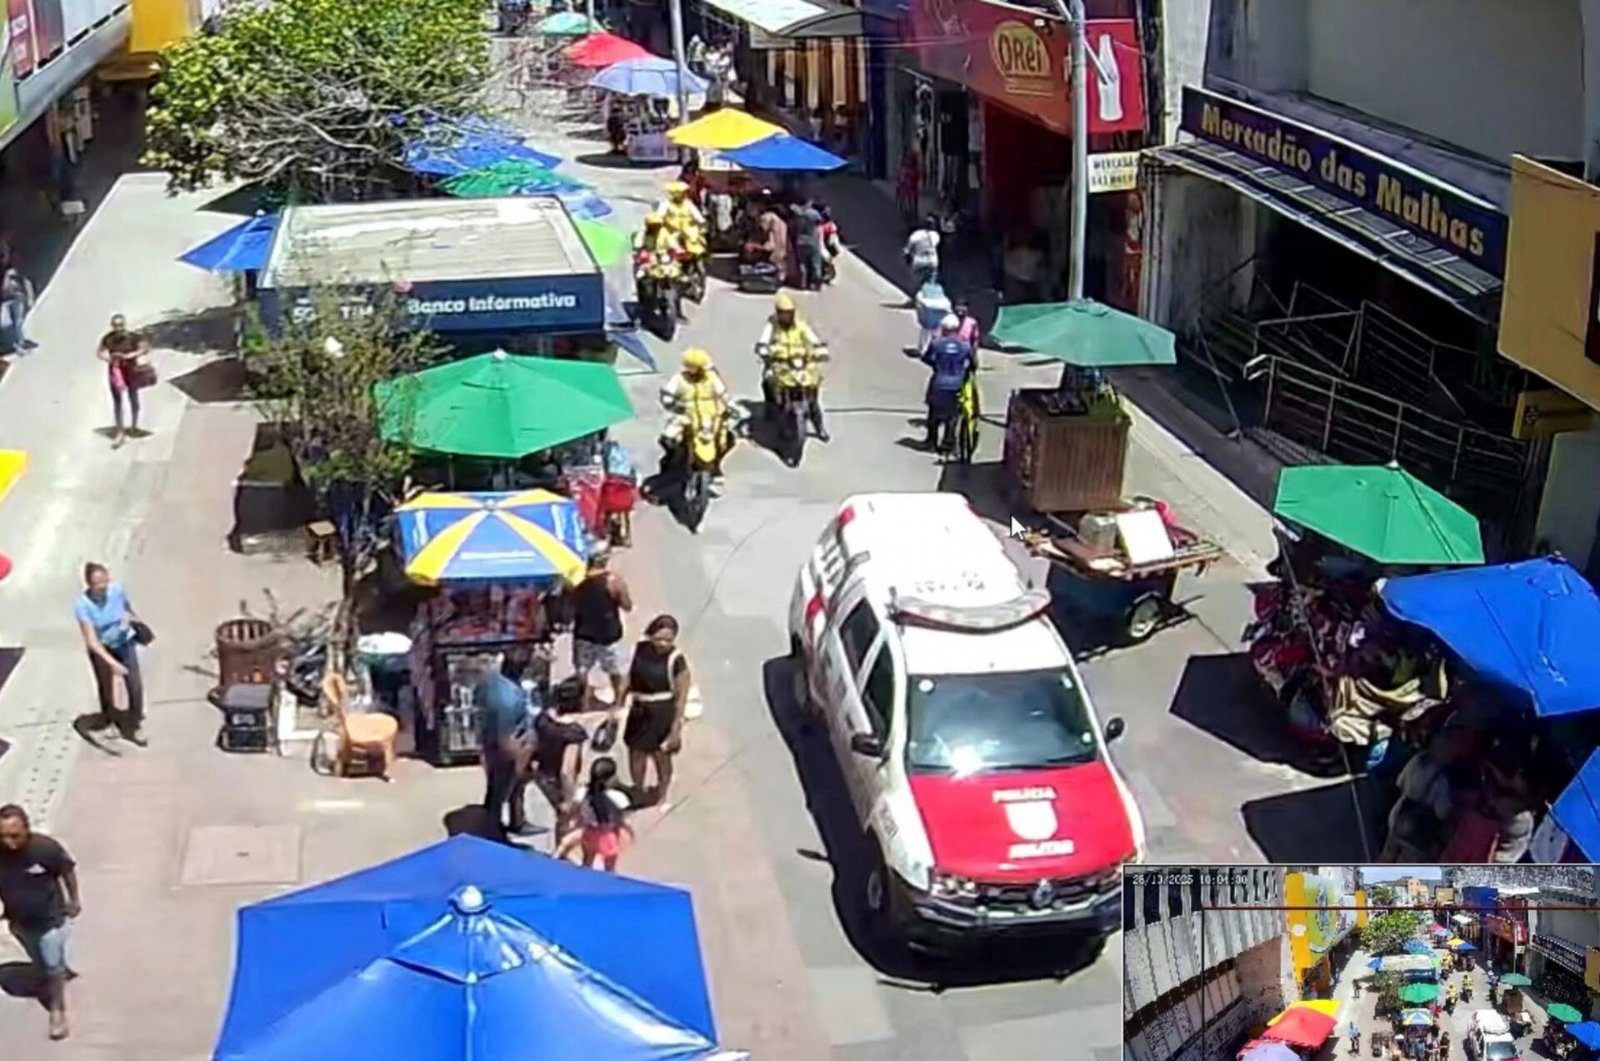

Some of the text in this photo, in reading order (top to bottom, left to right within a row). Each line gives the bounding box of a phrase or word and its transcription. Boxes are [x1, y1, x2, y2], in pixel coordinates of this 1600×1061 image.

[1201, 102, 1484, 256] Mercadão das Malhas
[469, 293, 575, 312] Informativa
